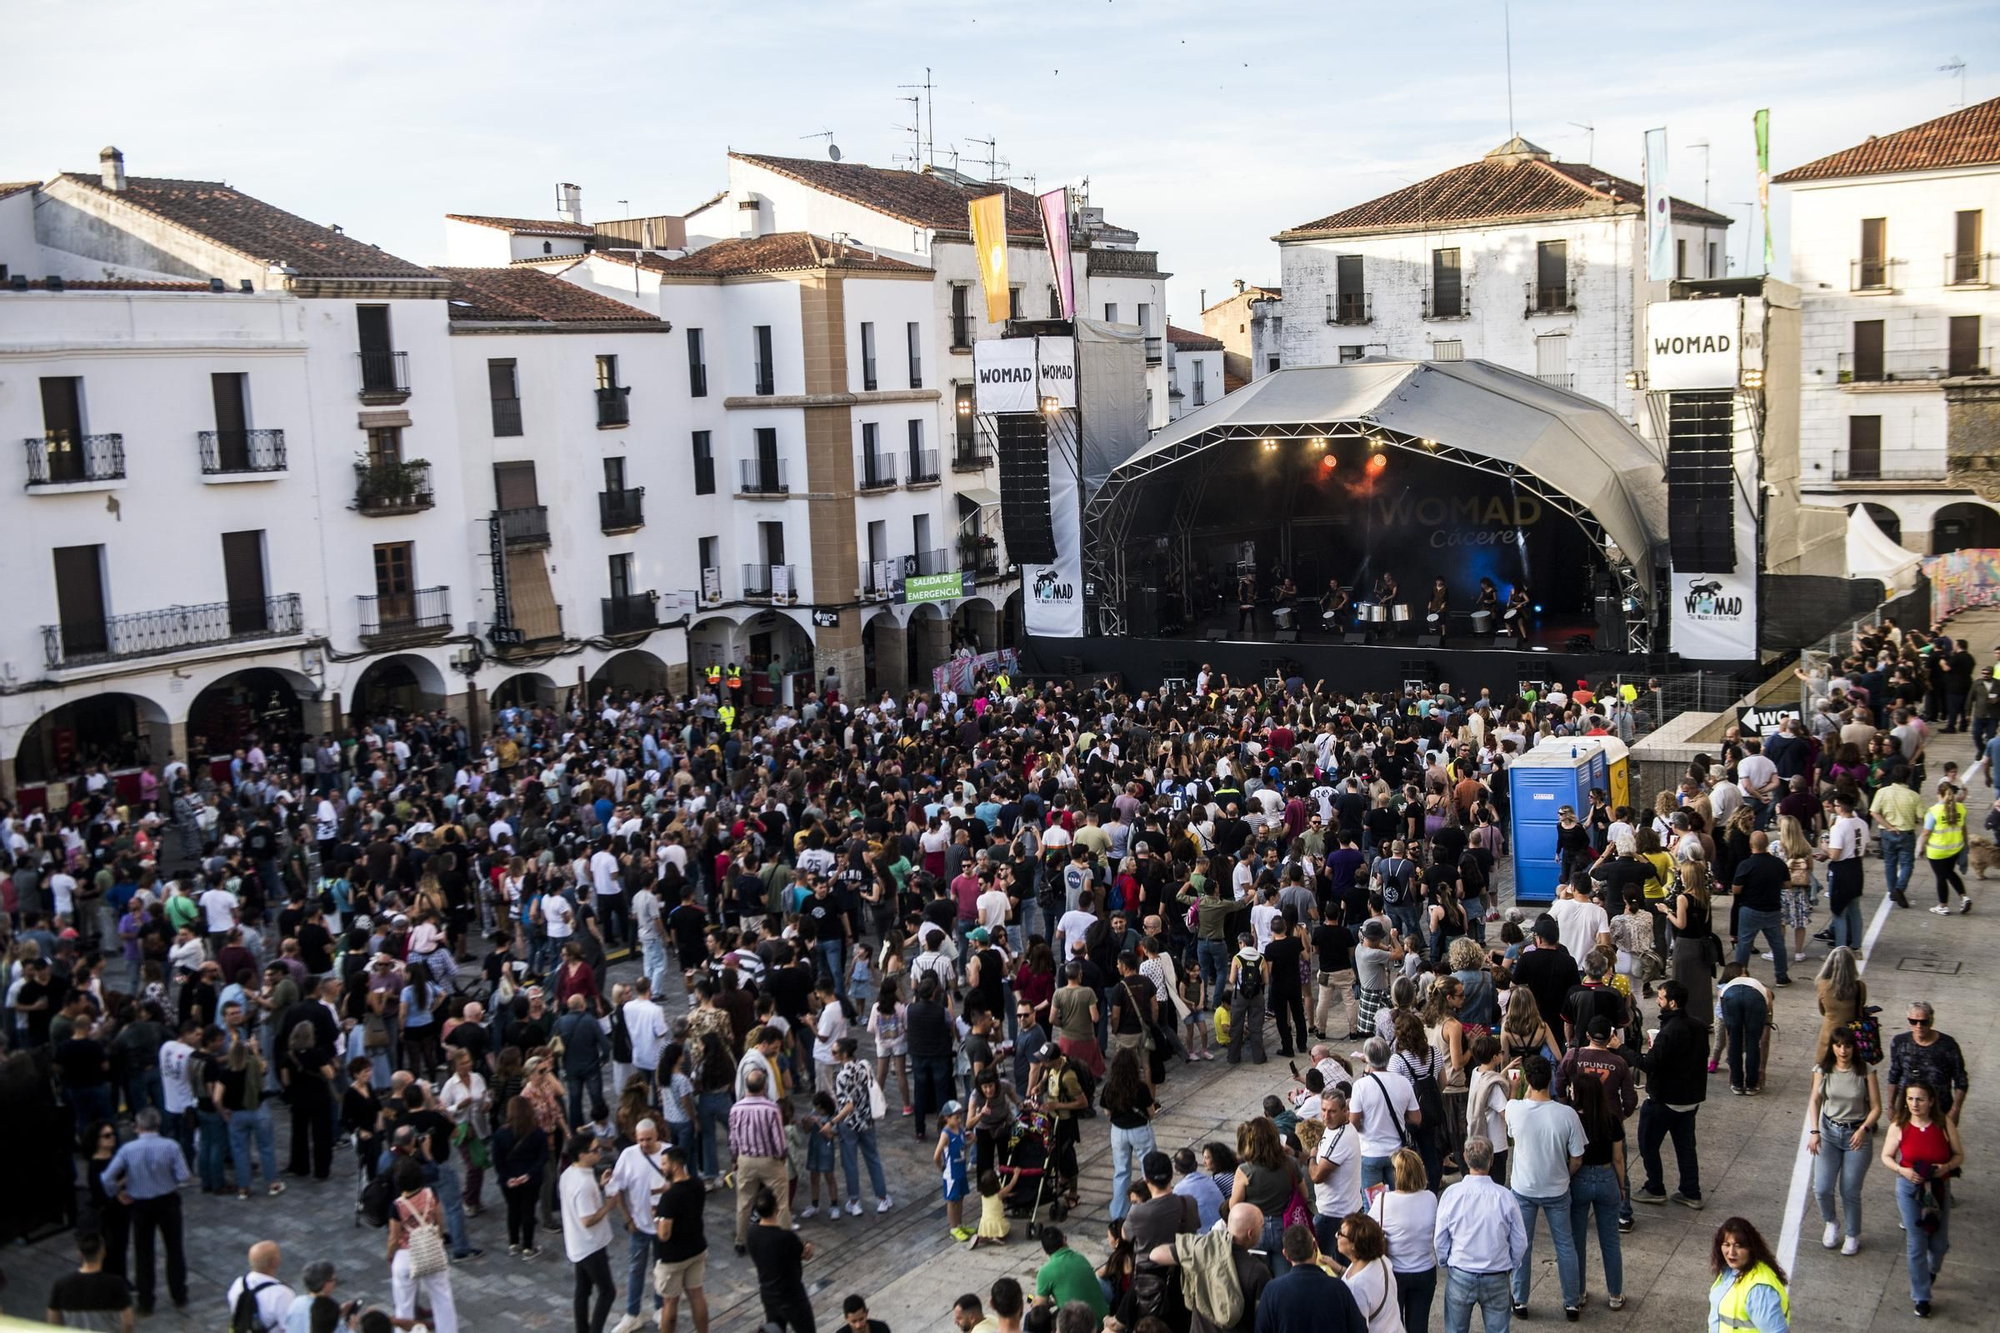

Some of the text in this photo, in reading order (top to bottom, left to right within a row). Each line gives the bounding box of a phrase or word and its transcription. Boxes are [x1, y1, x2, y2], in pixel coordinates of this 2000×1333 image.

[1654, 335, 1731, 355] WOMAD
[980, 367, 1032, 384] WOMAD
[1041, 364, 1073, 380] WOMAD
[1378, 496, 1542, 526] WOMAD
[912, 577, 940, 587] SALIDA
[942, 574, 954, 584] DE
[907, 587, 960, 601] EMERGENCIA
[820, 613, 834, 622] WC
[1758, 710, 1789, 726] WC
[807, 859, 821, 873] 25
[1577, 1061, 1616, 1071] YPUNTO
